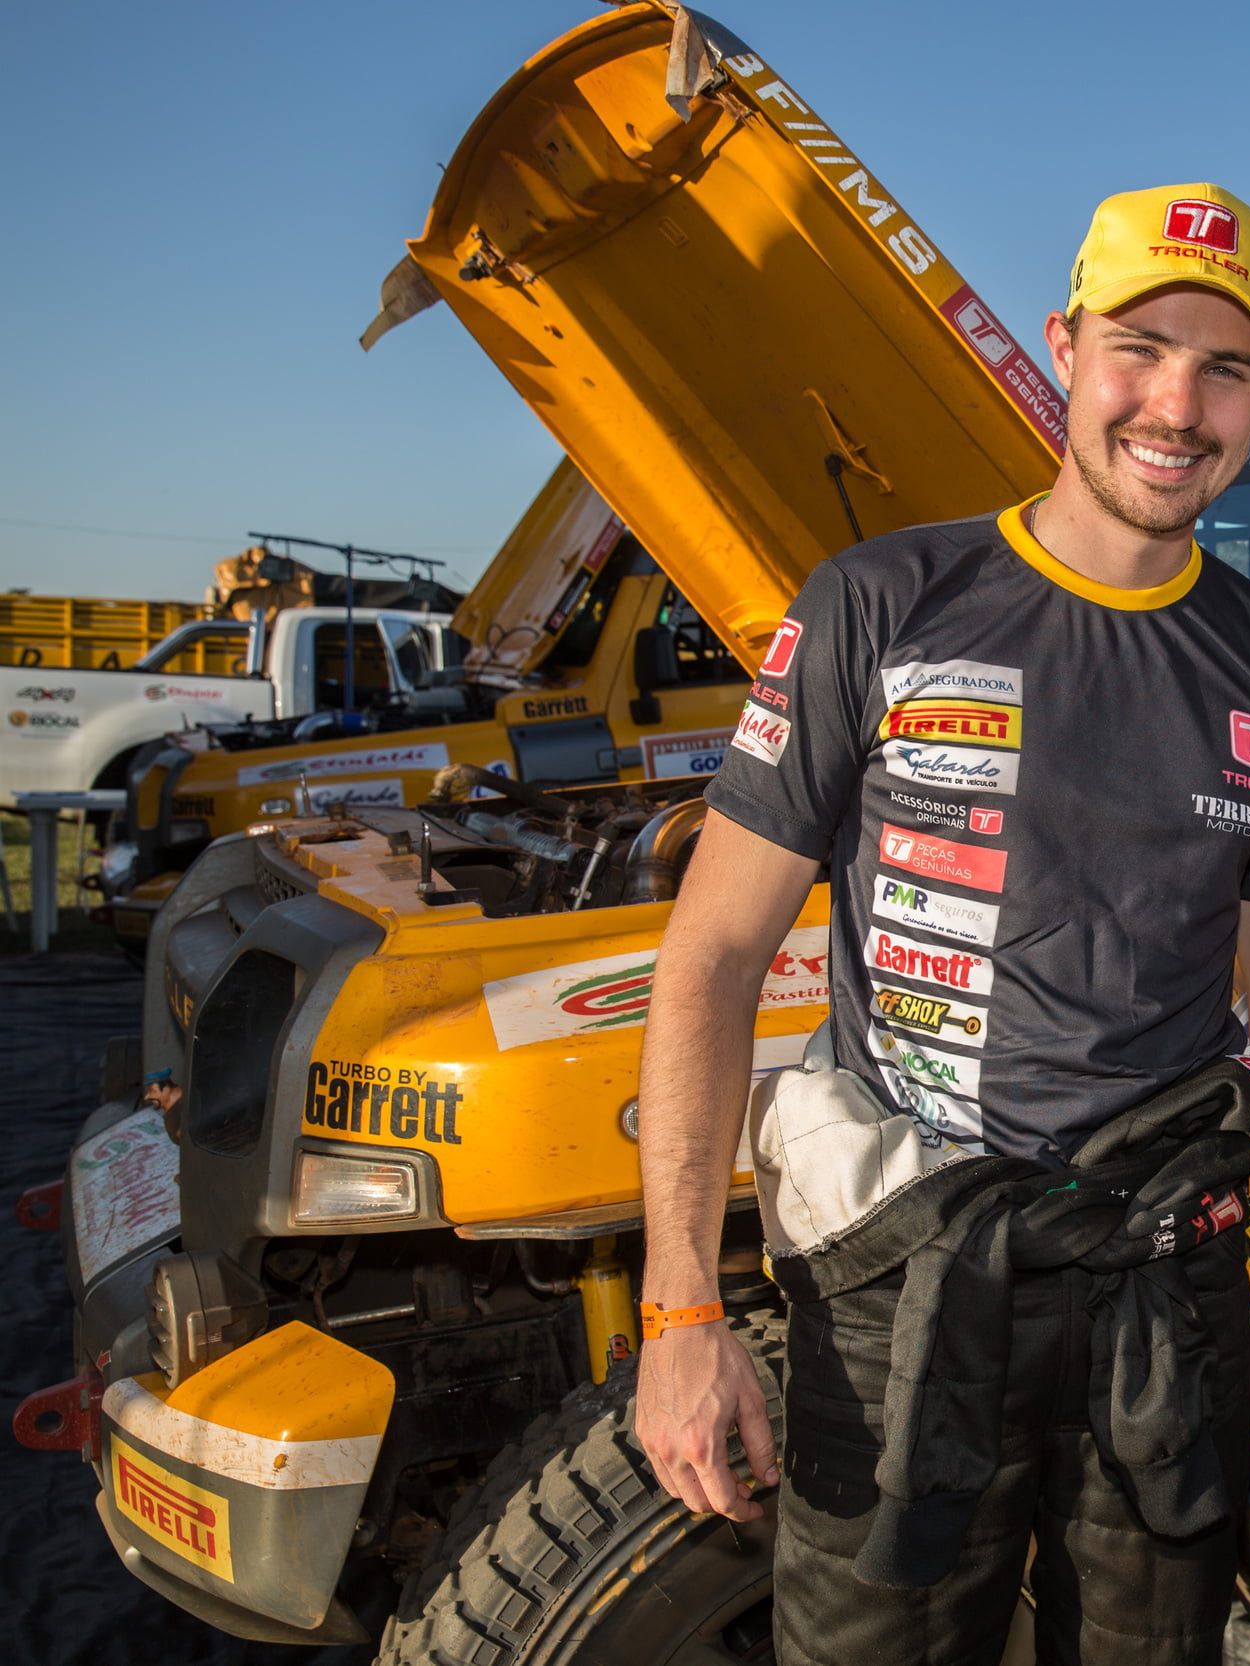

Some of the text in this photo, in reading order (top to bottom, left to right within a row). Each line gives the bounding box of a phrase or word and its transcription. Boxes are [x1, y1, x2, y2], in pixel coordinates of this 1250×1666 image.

[1148, 246, 1250, 282] TROLLER
[928, 674, 1016, 692] SEGURADORA
[523, 696, 590, 720] Garrett
[888, 707, 1010, 739] PIRELLI
[690, 756, 724, 773] GO
[896, 745, 1001, 777] Gabardo
[917, 772, 998, 788] TRANSPORTE DE VEÍCULOS
[890, 790, 968, 817] ACESSÓRIOS
[916, 811, 967, 830] ORIGINAIS
[916, 843, 957, 863] PEÇAS
[912, 857, 973, 881] GENUÍNAS
[882, 880, 985, 922] PMR seguros
[875, 934, 975, 989] Garrett
[878, 991, 949, 1027] ffSHOX
[330, 1060, 428, 1086] TURBO BY
[305, 1061, 464, 1145] Garrett
[117, 1452, 217, 1560] PIRELLI
